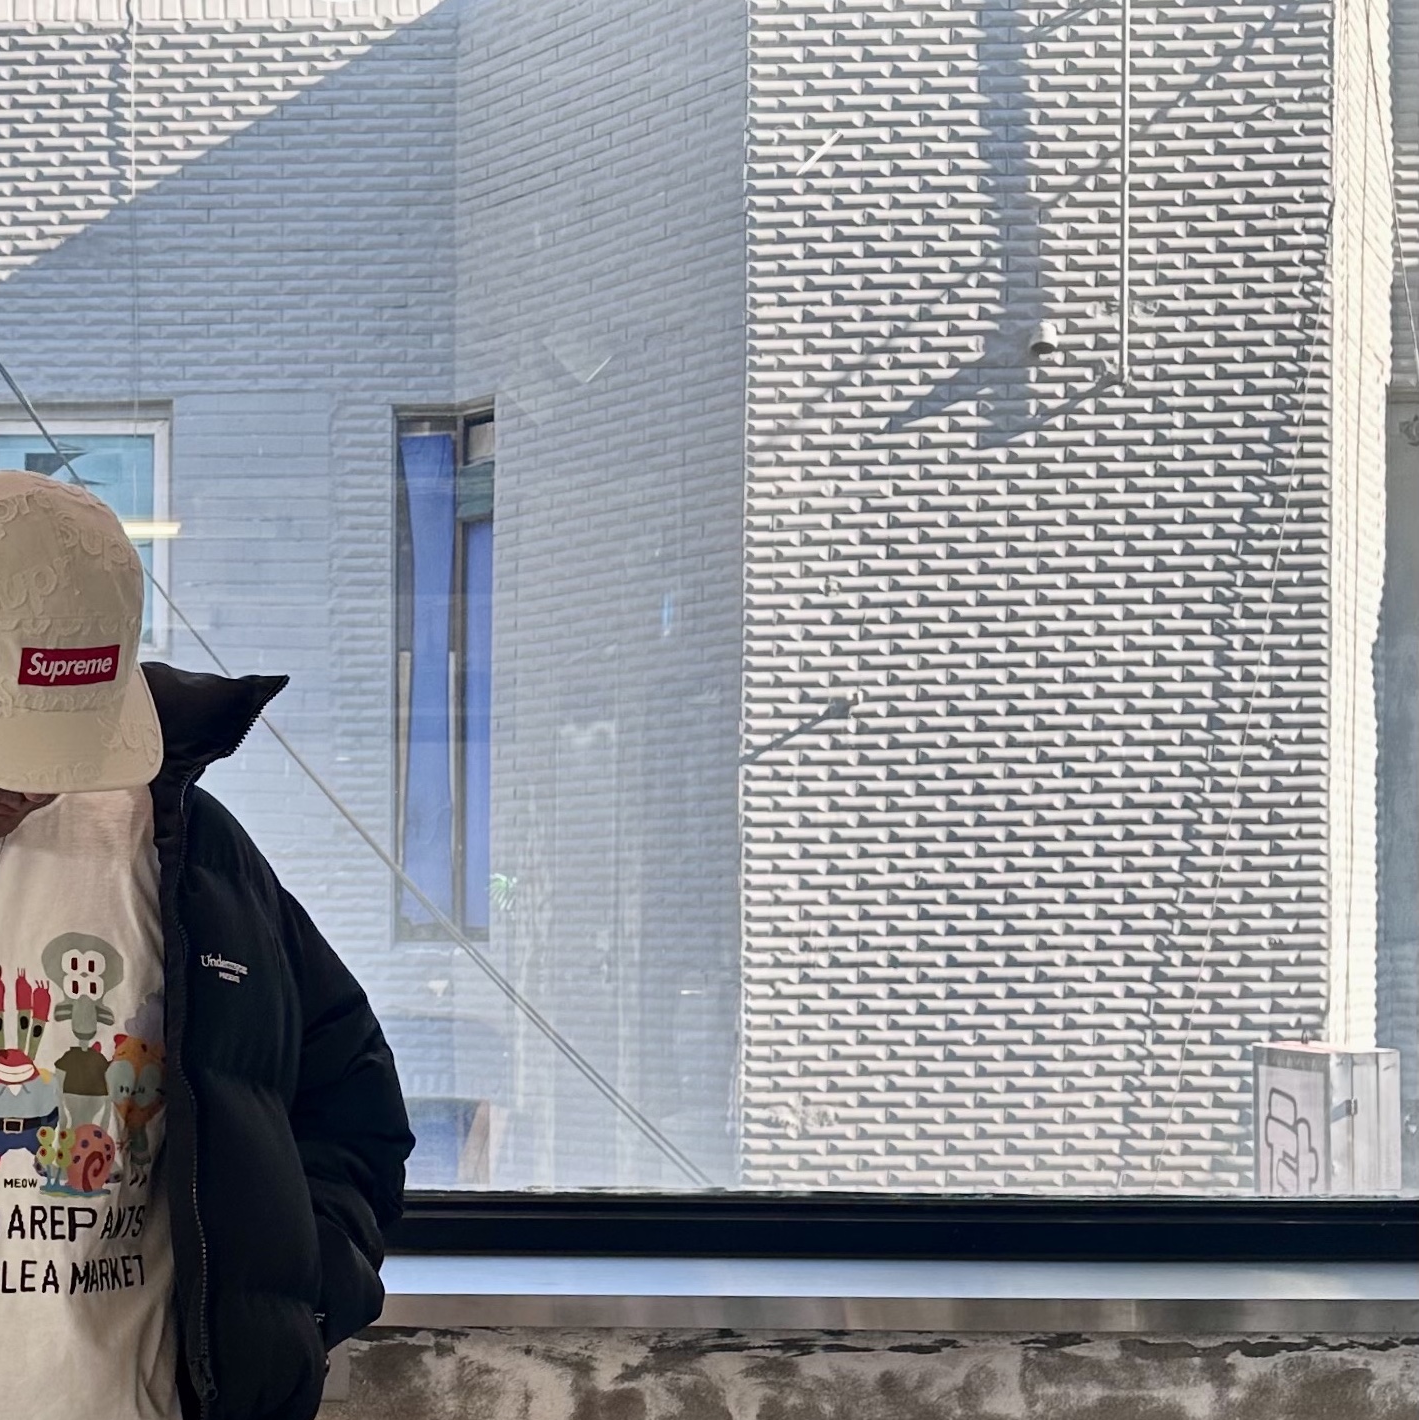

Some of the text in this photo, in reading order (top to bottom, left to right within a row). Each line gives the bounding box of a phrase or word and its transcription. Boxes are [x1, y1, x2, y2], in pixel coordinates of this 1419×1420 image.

[27, 652, 113, 683] Supreme
[3, 1178, 38, 1189] MEOW
[69, 1255, 145, 1295] MARKET
